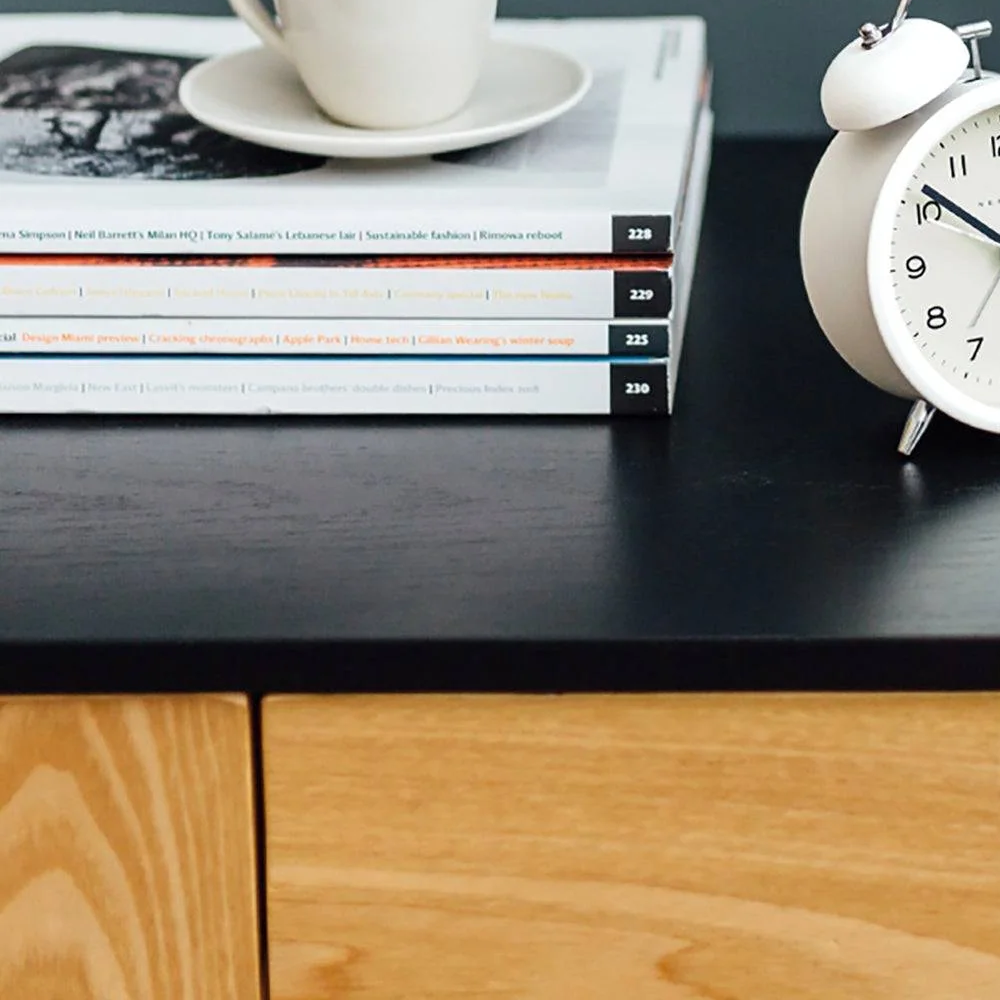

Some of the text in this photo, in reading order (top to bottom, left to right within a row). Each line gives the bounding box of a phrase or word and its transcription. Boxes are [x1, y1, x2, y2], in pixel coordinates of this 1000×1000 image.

[949, 154, 967, 178] 11
[916, 200, 942, 225] 10
[365, 230, 428, 240] Sustainable
[525, 231, 563, 240] reboot
[628, 228, 653, 240] 228
[905, 255, 927, 279] 9
[629, 289, 654, 301] 229
[926, 305, 947, 330] 8
[625, 334, 649, 346] 225
[966, 337, 984, 361] 7
[625, 383, 650, 395] 230
